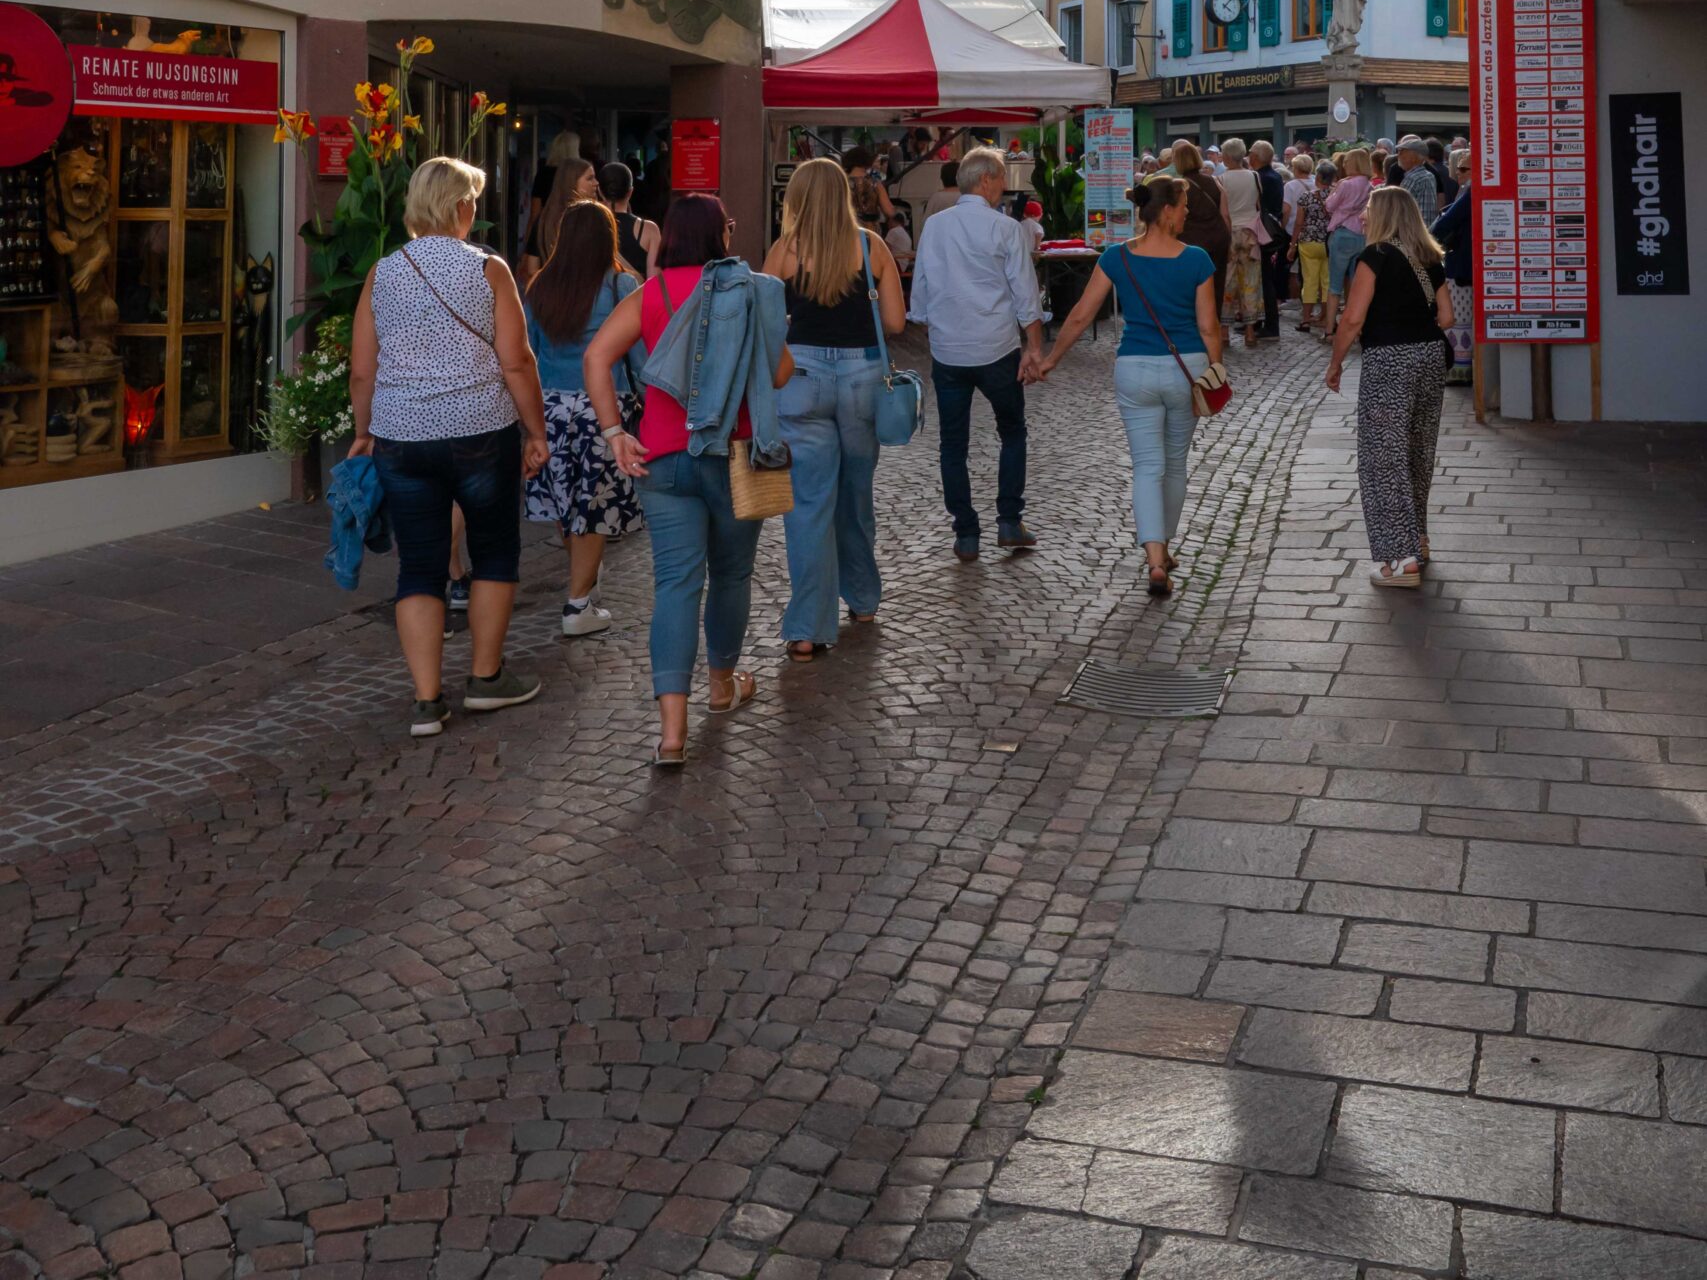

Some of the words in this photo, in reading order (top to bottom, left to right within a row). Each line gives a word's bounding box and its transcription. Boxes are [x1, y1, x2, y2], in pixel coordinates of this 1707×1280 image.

[82, 56, 139, 79] RENATE
[146, 62, 239, 86] NUJSONGSINN
[1483, 49, 1493, 72] das
[92, 81, 133, 97] Schmuck
[136, 86, 151, 99] der
[153, 87, 179, 101] etwas
[181, 89, 215, 103] anderen
[216, 90, 230, 104] Art
[1175, 76, 1195, 97] LA
[1198, 72, 1223, 95] VIE
[1224, 72, 1280, 89] BARBERSHOP
[1087, 114, 1115, 130] JAZZ
[1482, 76, 1494, 154] unterstützen
[1087, 125, 1112, 139] FEST
[1483, 158, 1495, 181] Wir
[1629, 113, 1670, 257] #ghdhair
[1636, 271, 1664, 286] ghd
